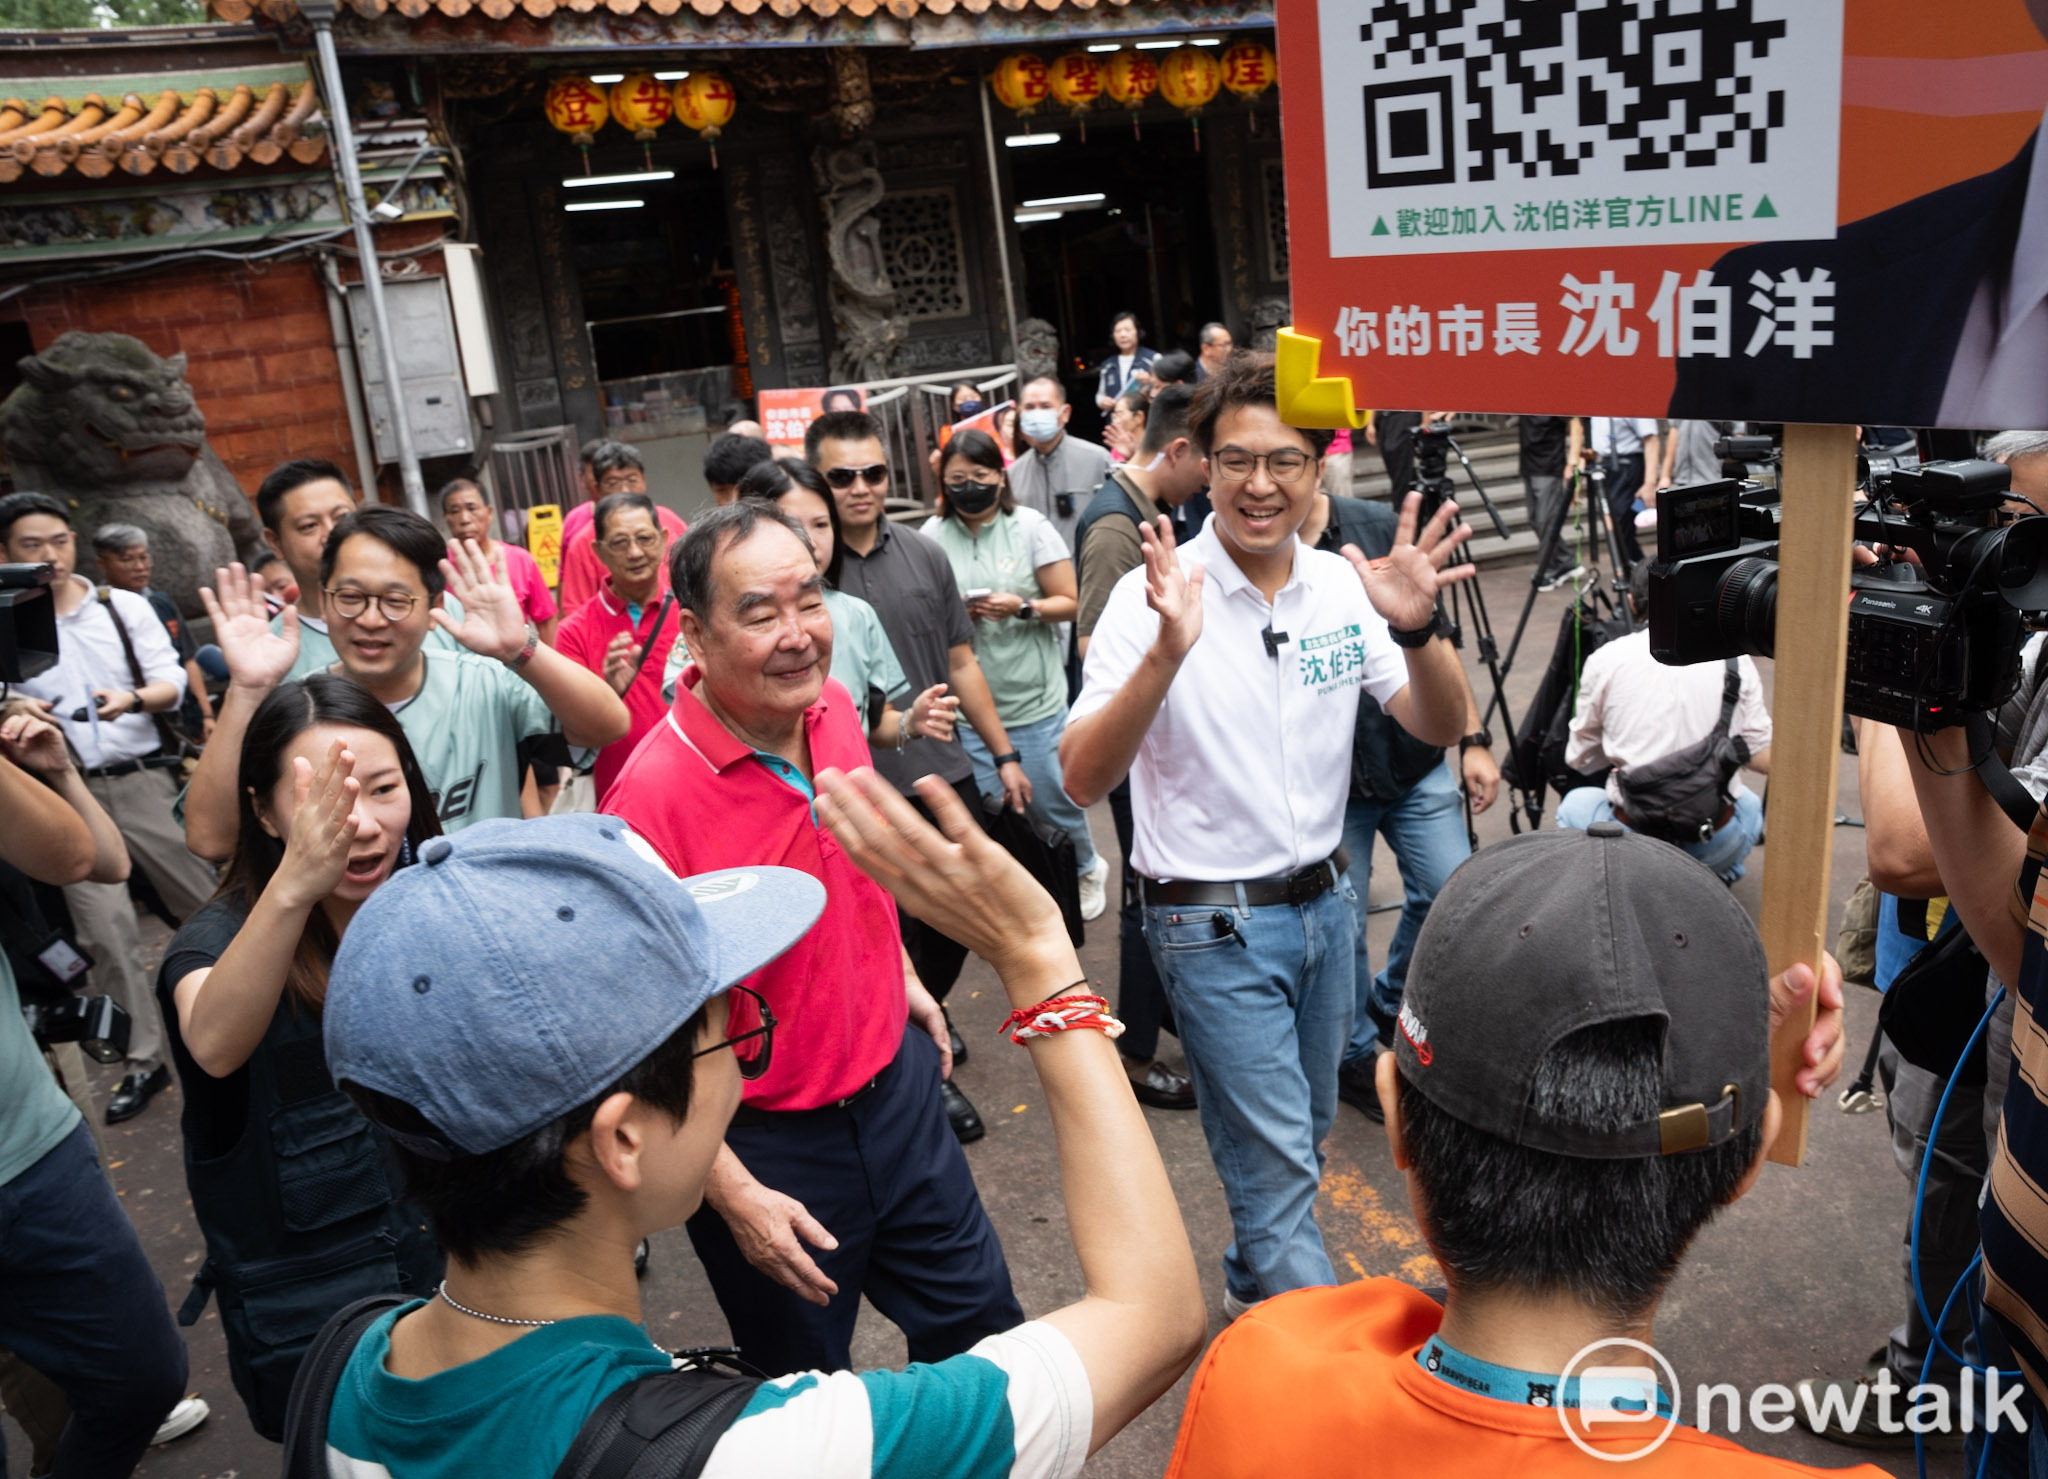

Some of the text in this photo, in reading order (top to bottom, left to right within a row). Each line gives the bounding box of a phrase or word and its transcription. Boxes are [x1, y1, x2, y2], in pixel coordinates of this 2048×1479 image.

[1396, 194, 1744, 239] 歡迎加入 沈伯洋官方LINE
[1334, 266, 1836, 359] 你的市長 沈伯洋
[766, 419, 812, 440] 沈伯
[1861, 597, 1934, 614] Panasonic 4K
[1299, 640, 1366, 686] 沈伯洋
